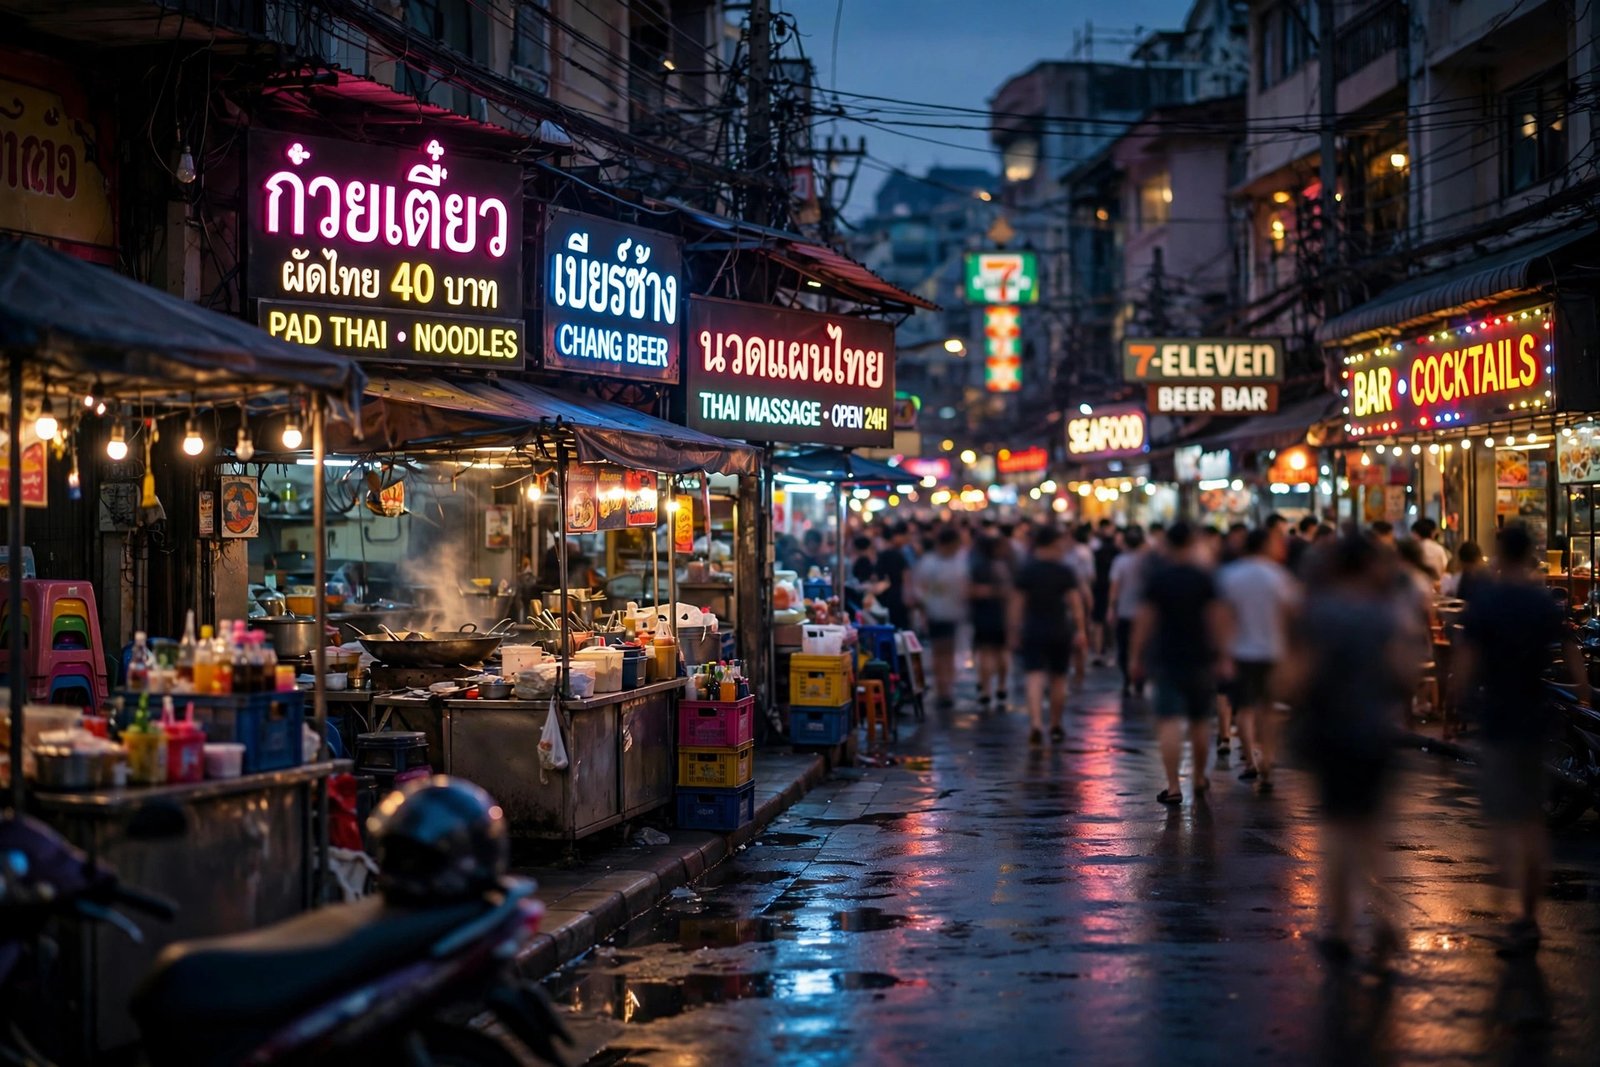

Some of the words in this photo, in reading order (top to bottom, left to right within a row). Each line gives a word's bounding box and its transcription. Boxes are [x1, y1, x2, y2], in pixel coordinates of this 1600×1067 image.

[282, 247, 380, 299] ผัดไทย
[390, 261, 435, 304] 40
[443, 275, 498, 309] บาท
[269, 310, 322, 345] PAD
[329, 316, 387, 350] THAI
[414, 322, 518, 359] NOODLES
[560, 323, 622, 362] CHANG
[626, 333, 669, 368] BEER
[700, 323, 884, 389] นวดแผนไทย
[1353, 366, 1393, 417] BAR
[1410, 333, 1537, 407] COCKTAILS
[699, 391, 741, 421] THAI
[745, 395, 822, 427] MASSAGE
[831, 403, 863, 429] OPEN
[864, 406, 888, 431] 24H
[1157, 386, 1216, 412] BEER
[1221, 386, 1268, 412] BAR
[1067, 413, 1145, 455] SEAFOOD
